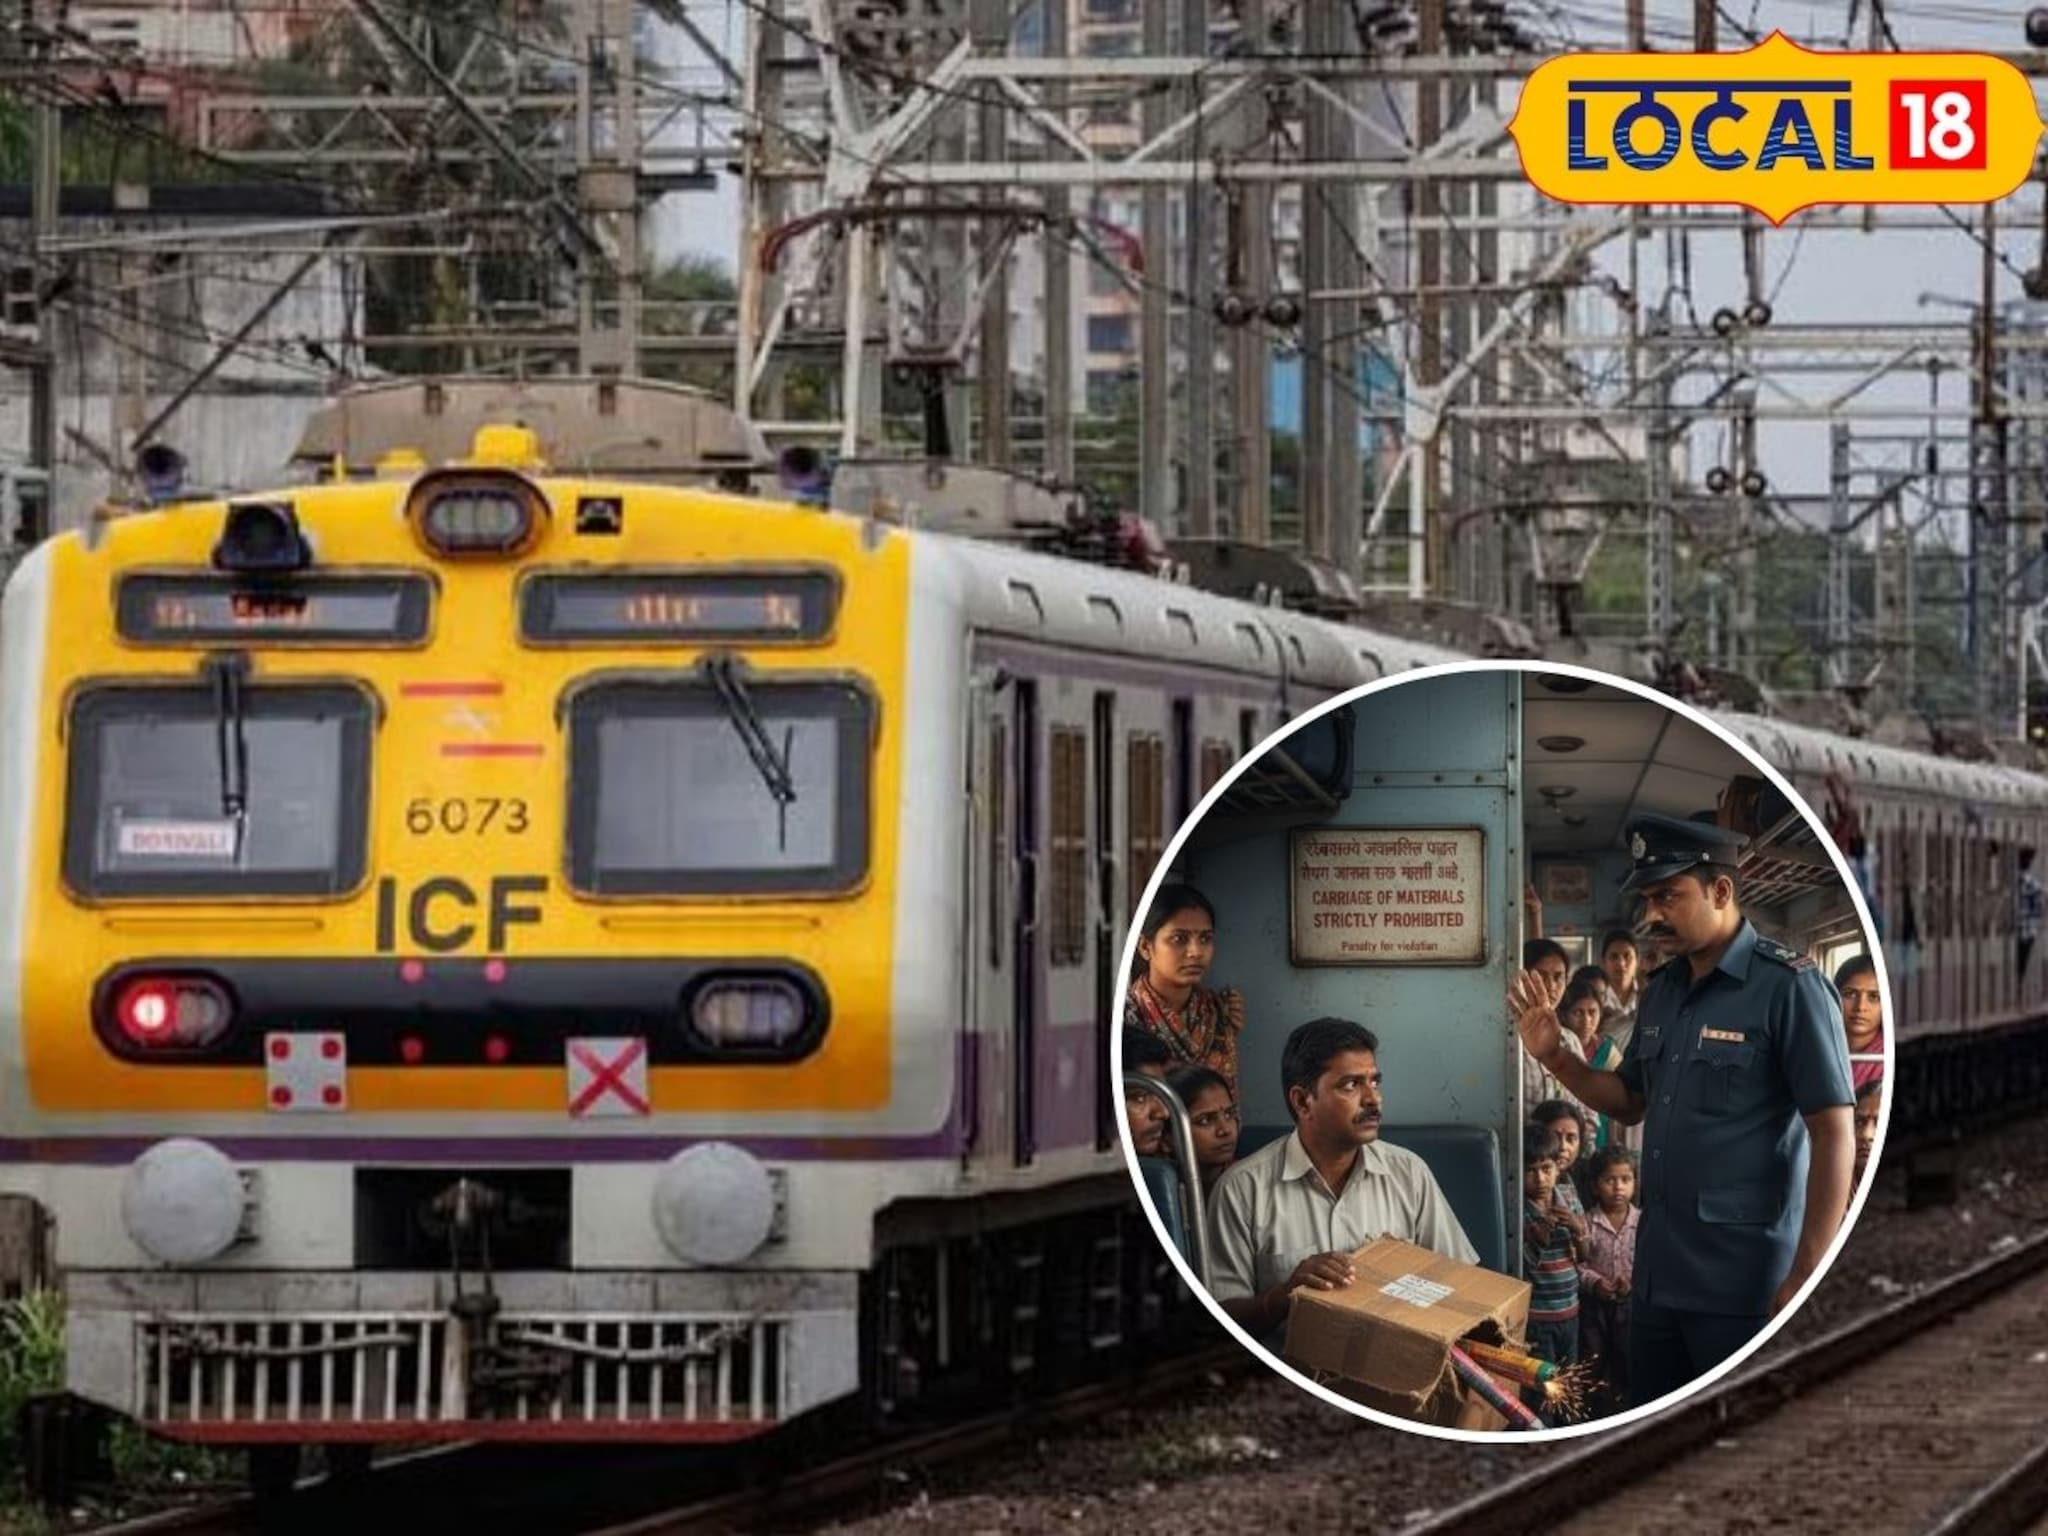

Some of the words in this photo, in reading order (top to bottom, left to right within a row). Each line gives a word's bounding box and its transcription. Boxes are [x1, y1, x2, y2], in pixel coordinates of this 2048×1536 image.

[406, 797, 530, 836] 6073
[1312, 890, 1373, 905] CARRIAGE
[1377, 890, 1393, 905] OF
[1397, 890, 1464, 904] MATERIALS
[375, 875, 549, 952] ICF
[1313, 913, 1378, 928] STRICTLY
[1383, 912, 1464, 927] PROHIBITED
